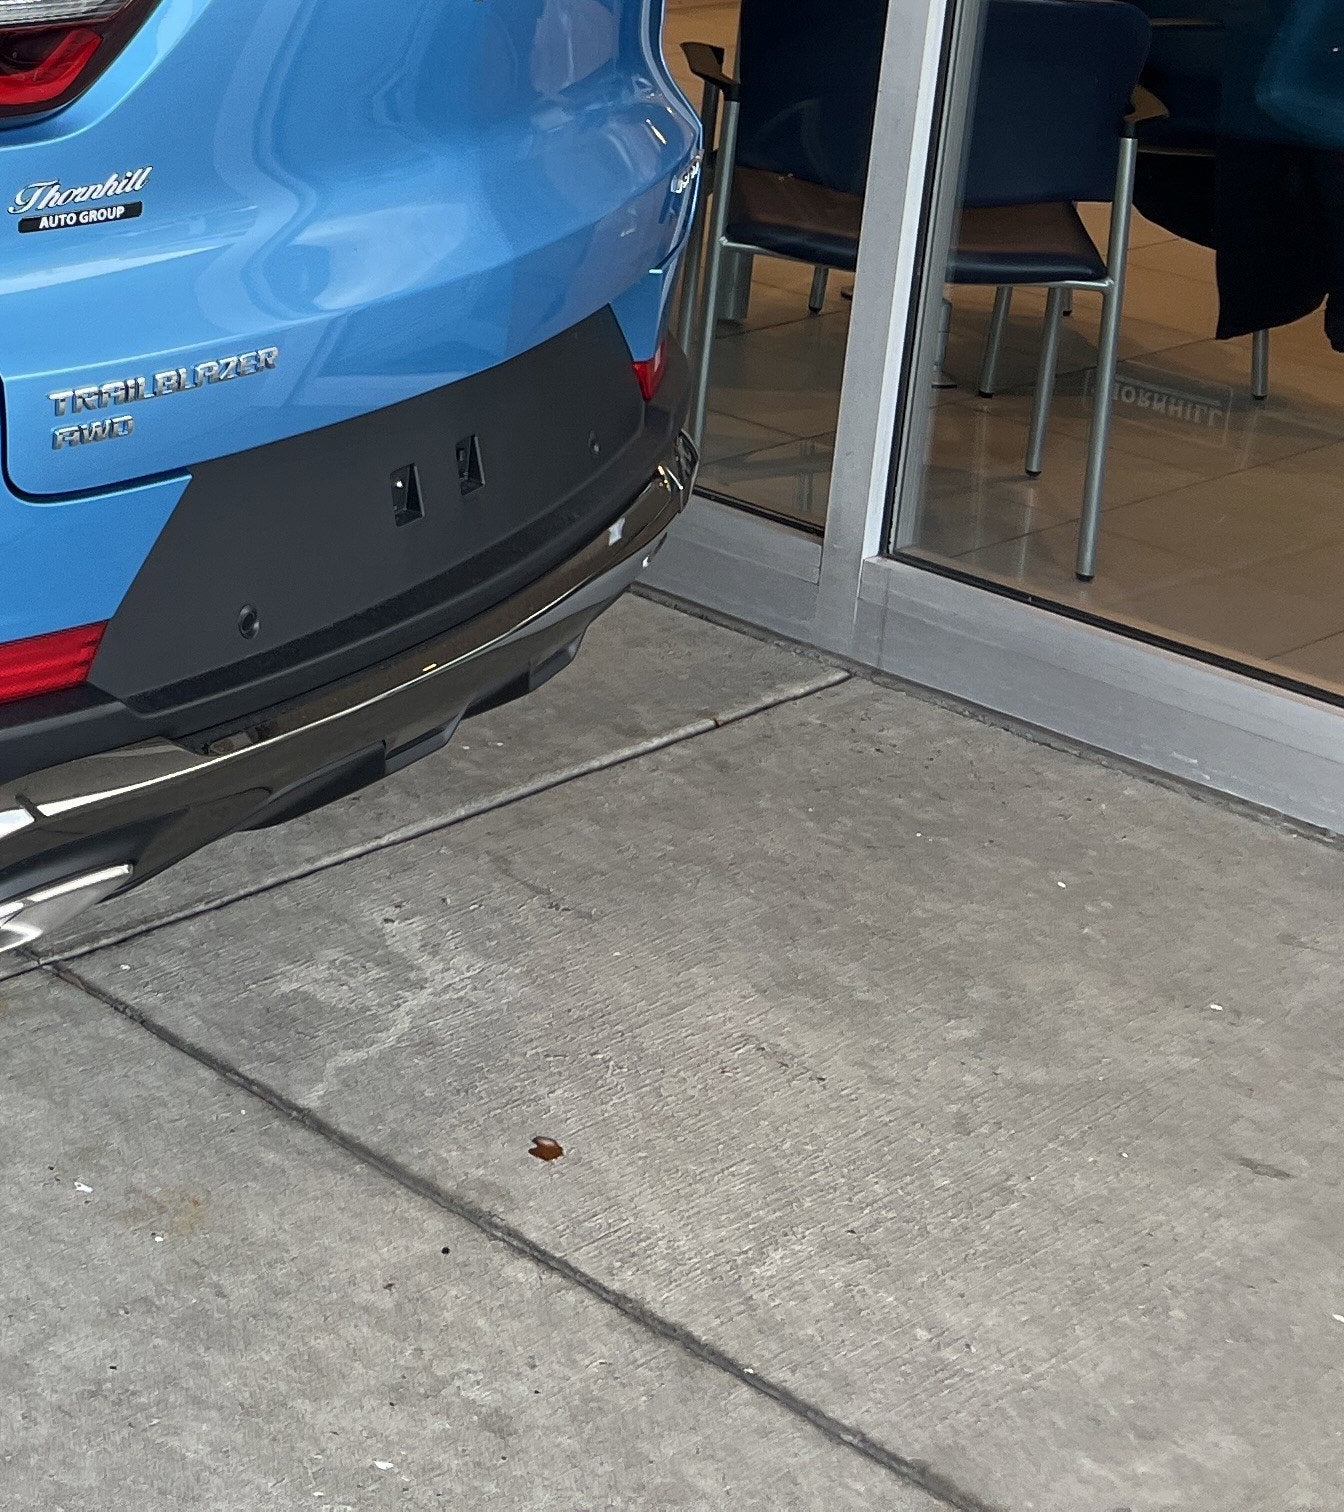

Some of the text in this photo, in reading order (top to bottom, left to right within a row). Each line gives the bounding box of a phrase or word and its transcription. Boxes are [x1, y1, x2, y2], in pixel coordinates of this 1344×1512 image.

[7, 166, 153, 215] Thornhill
[38, 205, 125, 229] AUTO GROUP
[48, 346, 279, 417] TRAILBLAZER
[51, 414, 134, 450] AWD
